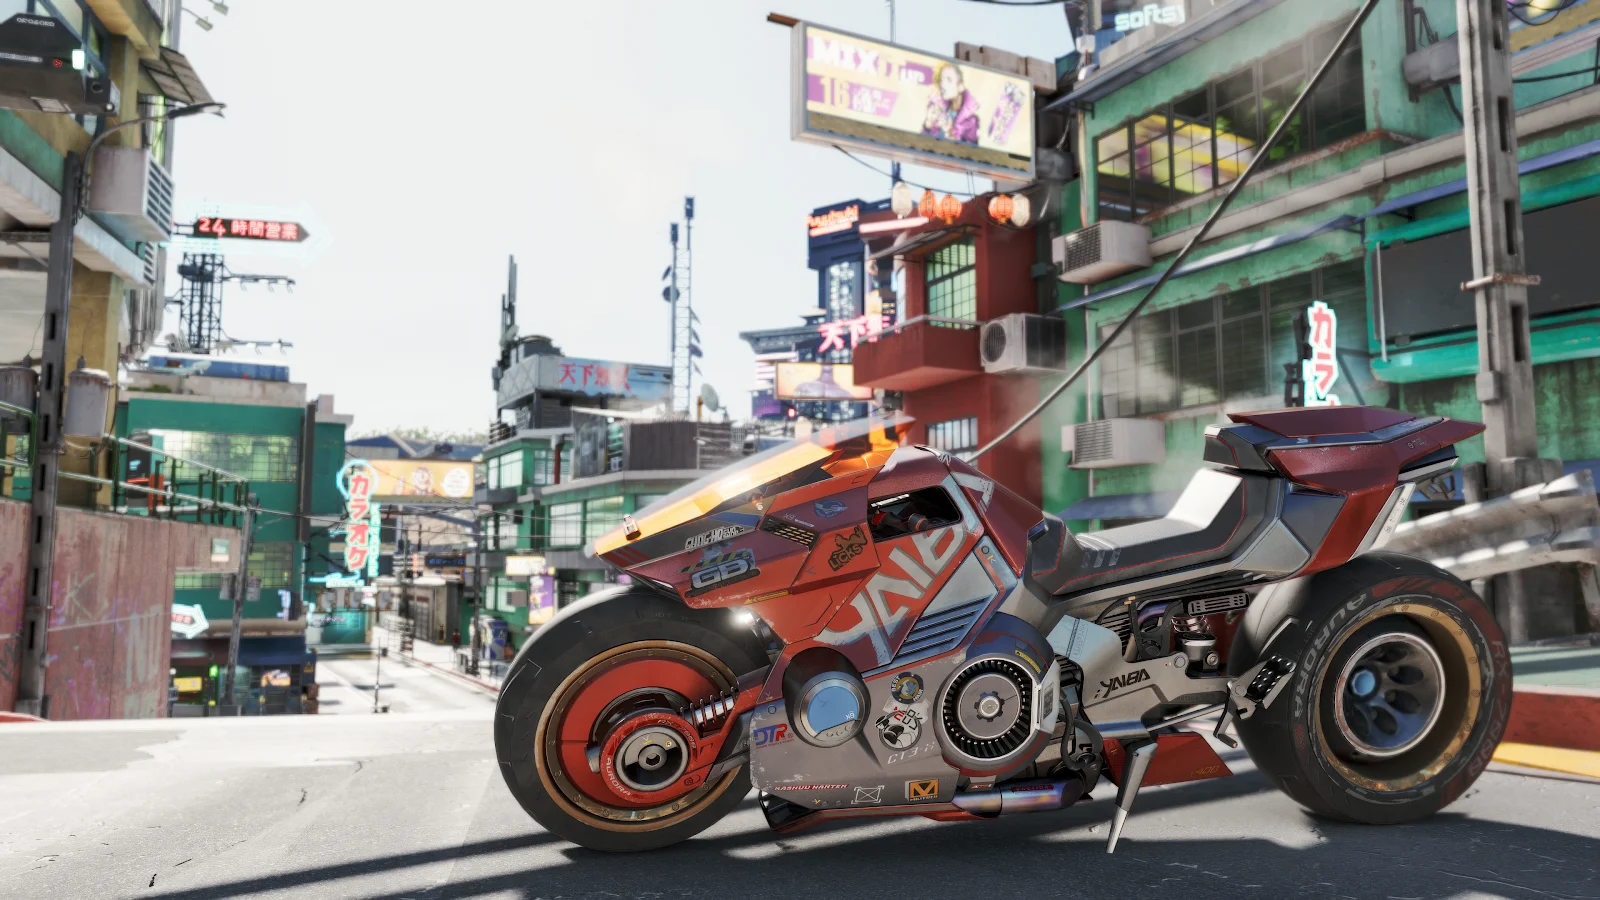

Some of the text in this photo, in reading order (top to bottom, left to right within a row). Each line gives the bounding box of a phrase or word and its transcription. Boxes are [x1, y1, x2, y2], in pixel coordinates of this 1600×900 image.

[812, 36, 879, 77] MIX
[198, 216, 299, 240] 24 時間営業
[1312, 306, 1336, 406] カラ
[348, 474, 369, 570] カラオケ
[1294, 593, 1367, 718] AURORA
[606, 757, 631, 796] AURORA
